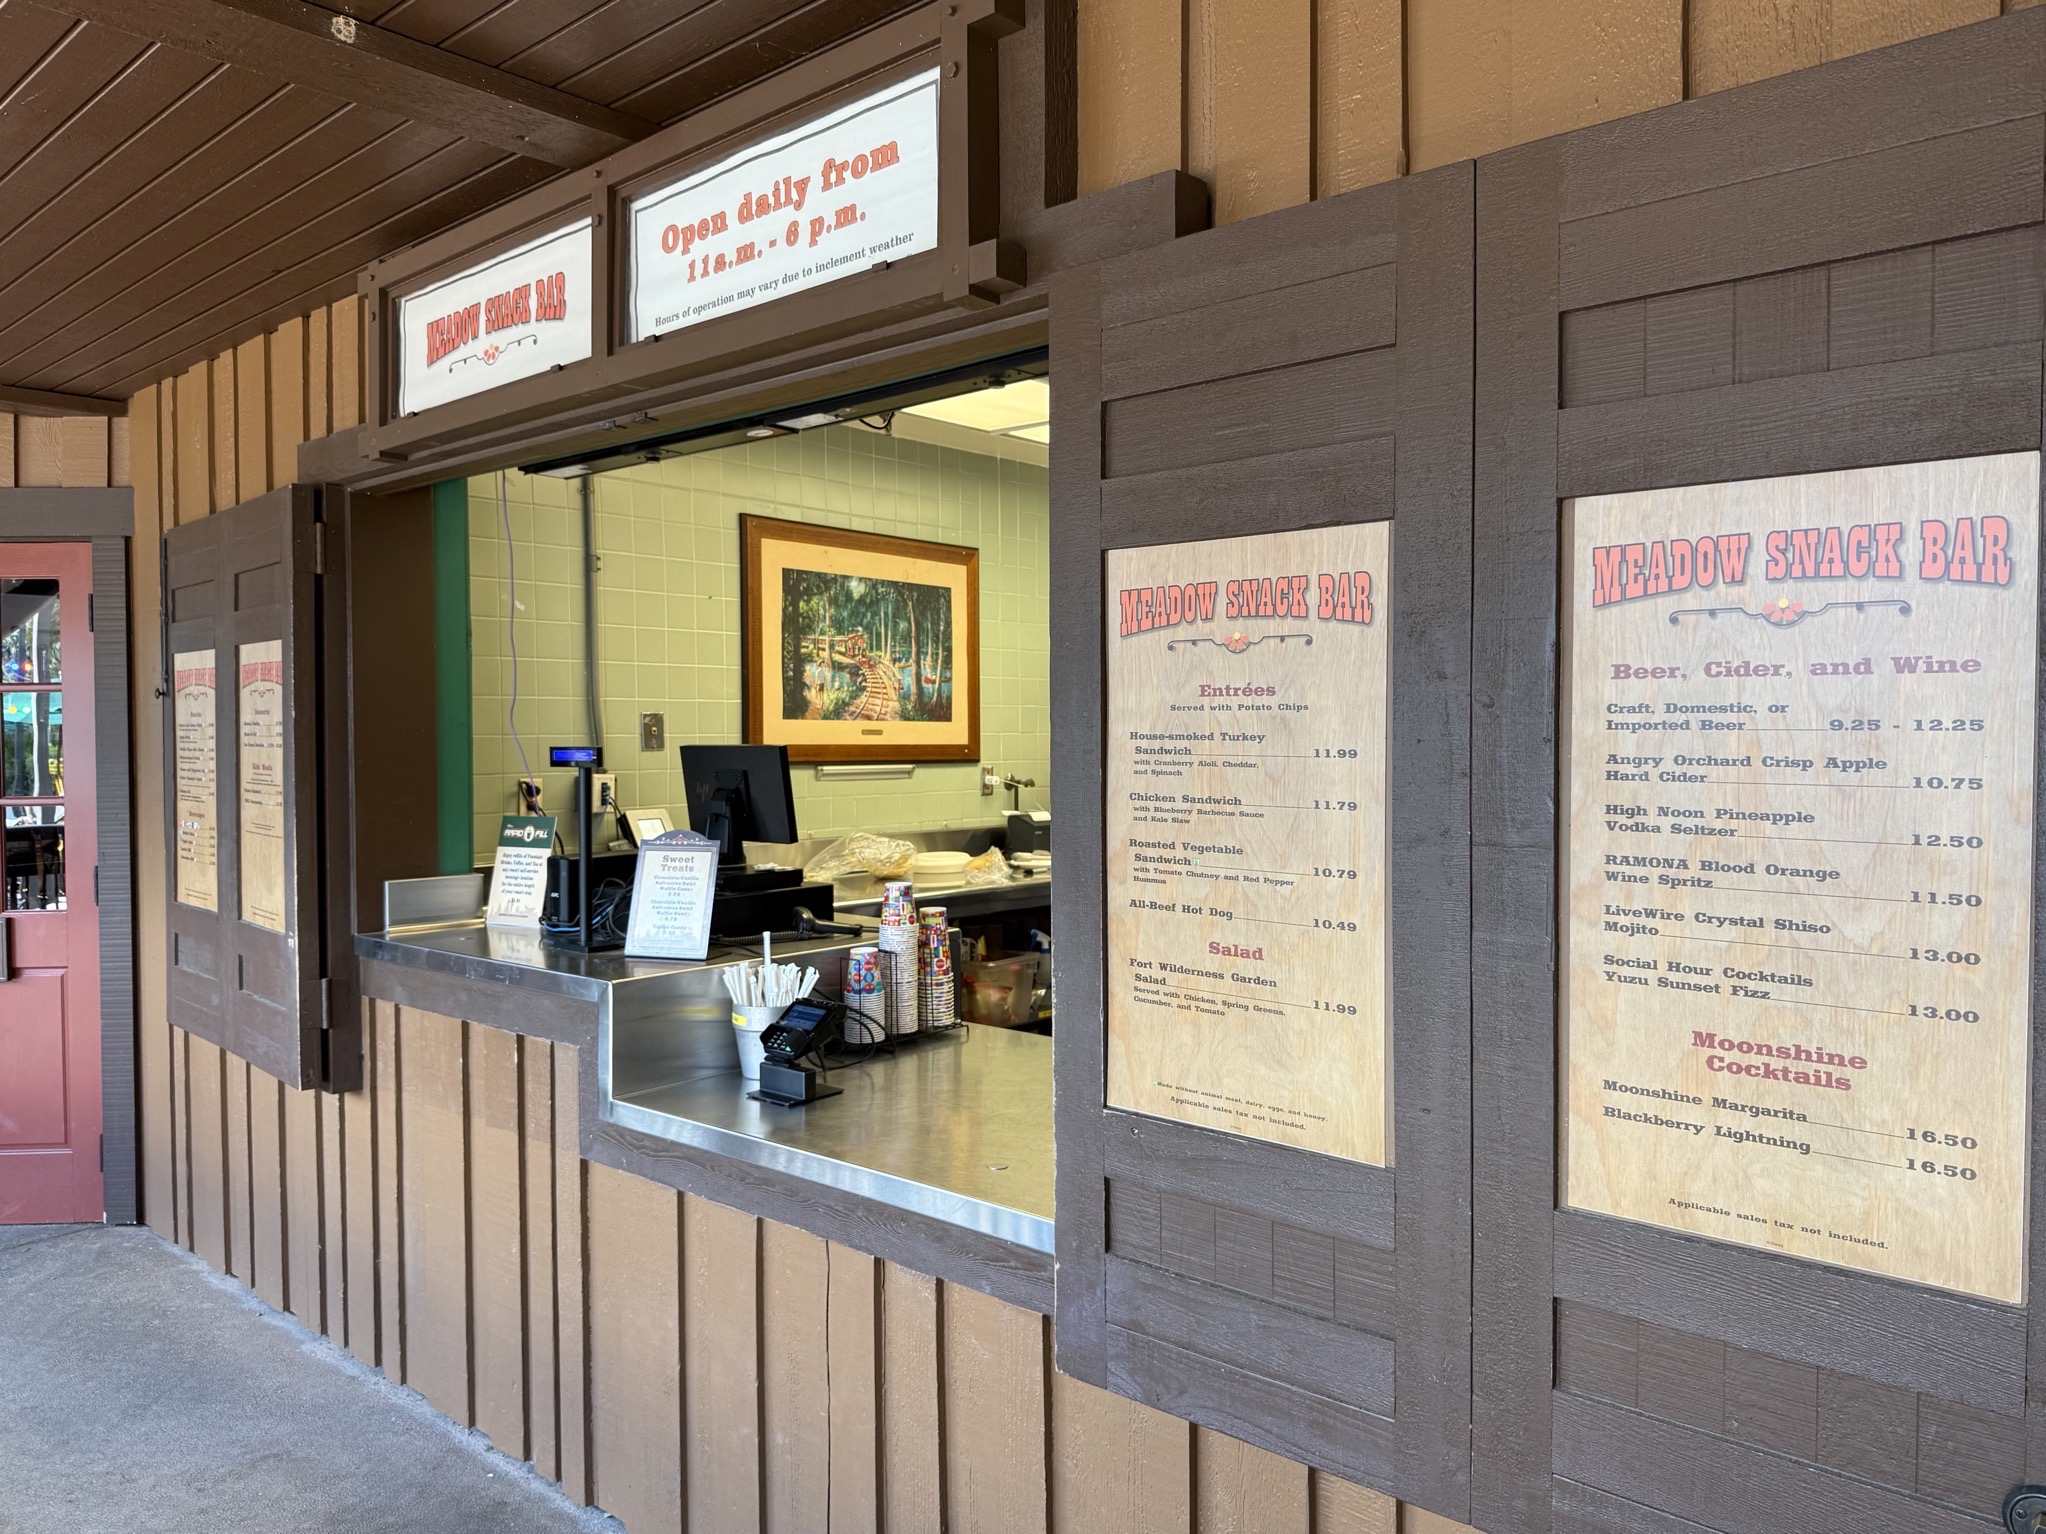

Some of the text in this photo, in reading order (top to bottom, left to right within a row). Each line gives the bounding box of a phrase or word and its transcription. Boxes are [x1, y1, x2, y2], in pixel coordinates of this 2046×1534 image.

[662, 141, 899, 259] Open daily from
[684, 201, 866, 283] 11a.m. - 6 p.m.
[655, 233, 917, 327] Hours of operation may vary due to inclement weather
[427, 272, 566, 367] MEADOW SNACK BAR
[1593, 515, 2013, 610] MEADOW SNACK BAR
[1120, 571, 1373, 639] MEADOW SNACK BAR
[1611, 656, 1981, 681] Beer, Cider, and Wine
[1199, 682, 1276, 697] Entrées
[1278, 703, 1308, 712] Chips
[1606, 702, 1789, 715] Craft, Domestic, or
[1130, 732, 1266, 744] House-smoked Turkey
[1606, 720, 1694, 733] Imported
[1699, 720, 1746, 731] Beer
[1829, 719, 1881, 731] 9.25
[1913, 719, 1984, 731] 12.25
[1135, 746, 1357, 758] Sandwich 11.99
[1154, 760, 1194, 768] Cranberry
[1605, 754, 1887, 772] Angry Orchard Crisp Apple
[1151, 769, 1182, 777] Spinach
[1605, 771, 1983, 790] Hard Cider 10.75
[1130, 793, 1357, 811] Chicken Sandwich 11.79
[1154, 807, 1193, 815] Blueberry
[1605, 805, 1815, 825] High Noon Pineapple
[1129, 839, 1243, 855] Roasted Vegetable
[1605, 821, 1983, 848] Vodka Seltzer 12.50
[660, 864, 695, 872] Treats
[662, 854, 695, 863] Sweet
[1135, 853, 1357, 879] Sandwich 10.79
[1604, 855, 1840, 882] RAMONA Blood Orange
[1134, 876, 1166, 884] Hummus
[1153, 868, 1182, 876] Tomato
[1186, 871, 1220, 880] Chutney
[1264, 878, 1294, 886] Pepper
[1604, 871, 1982, 907] Wine Spritz 11.50
[1129, 899, 1356, 931] All-Beef Hot Dog 10.49
[1604, 905, 1831, 933] LiveWire Crystal Shiso
[1209, 941, 1264, 960] Salad
[1604, 921, 1981, 965] Mojito 13.00
[1130, 958, 1277, 987] Fort Wilderness Garden
[1604, 955, 1813, 990] Social Hour Cocktails
[1134, 986, 1160, 995] Served
[1184, 994, 1218, 1005] Chicken,
[1222, 1000, 1249, 1011] Spring
[1253, 1005, 1285, 1016] Greens,
[1134, 996, 1173, 1007] Cucumber,
[1195, 1006, 1225, 1016] Tomato
[1135, 973, 1357, 1015] Salad 11.99
[1603, 971, 1980, 1023] Yuzu Sunset Fizz 13.00
[1692, 1031, 1867, 1073] Moonshine
[1706, 1053, 1855, 1091] Cocktails
[1170, 1096, 1209, 1109] Applicable
[1213, 1106, 1232, 1114] sales
[1270, 1117, 1306, 1130] included.
[1176, 1085, 1198, 1094] without
[1201, 1091, 1222, 1099] animal
[1246, 1100, 1264, 1108] dairy,
[1304, 1112, 1327, 1122] honey.
[1603, 1080, 1977, 1149] Moonshine Margarita 16.50
[1603, 1106, 1977, 1180] Blackberry Lightning 16.50
[1668, 1198, 1888, 1249] Applicable sales tax not included.
